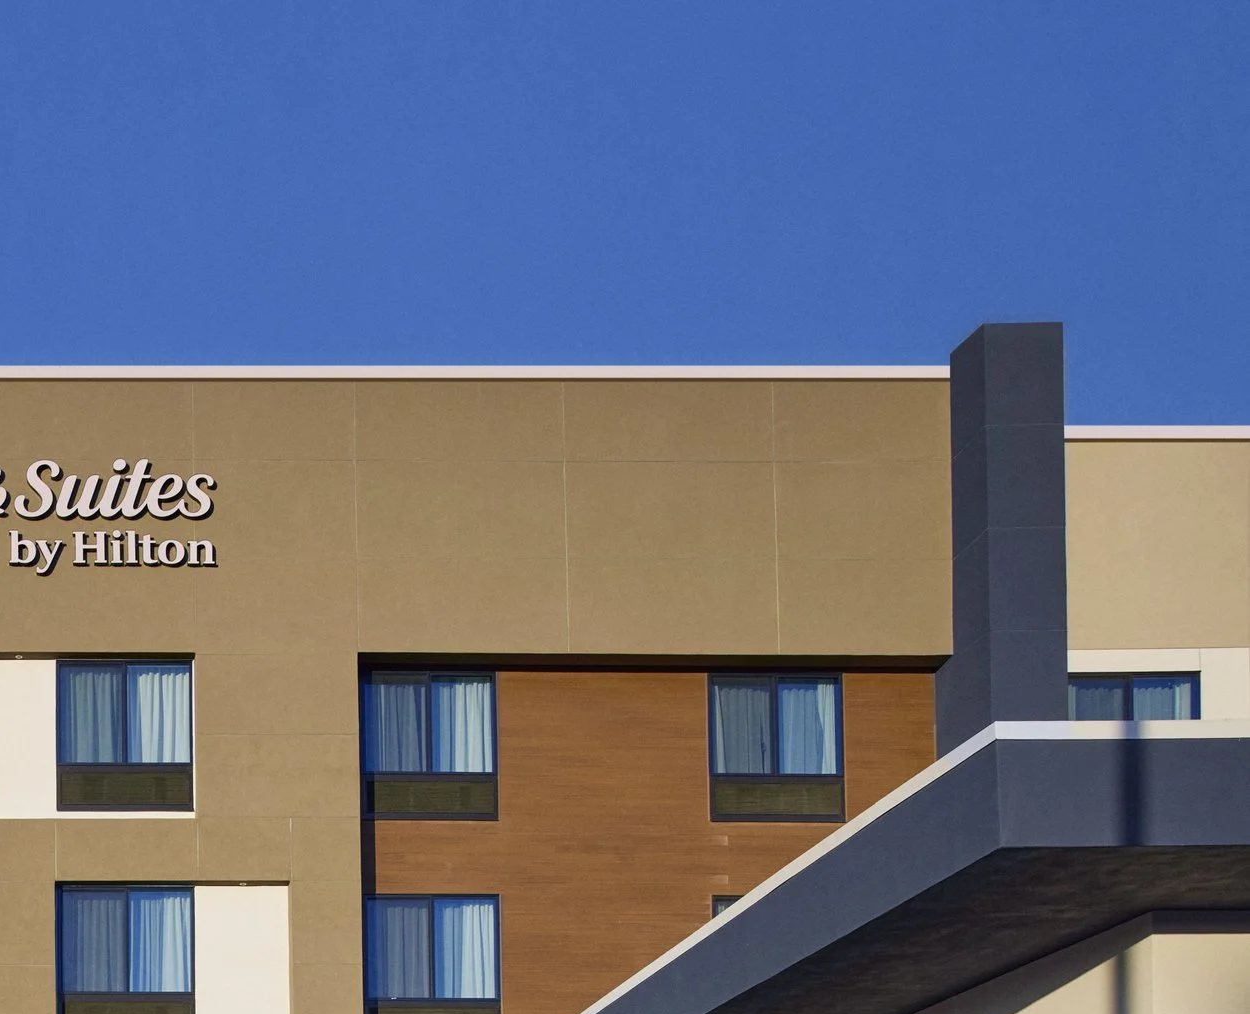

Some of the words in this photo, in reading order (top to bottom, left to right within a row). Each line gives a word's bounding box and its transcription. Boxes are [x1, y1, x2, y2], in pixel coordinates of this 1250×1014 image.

[14, 458, 216, 518] Suites
[9, 530, 63, 574] by
[72, 530, 216, 565] Hilton
